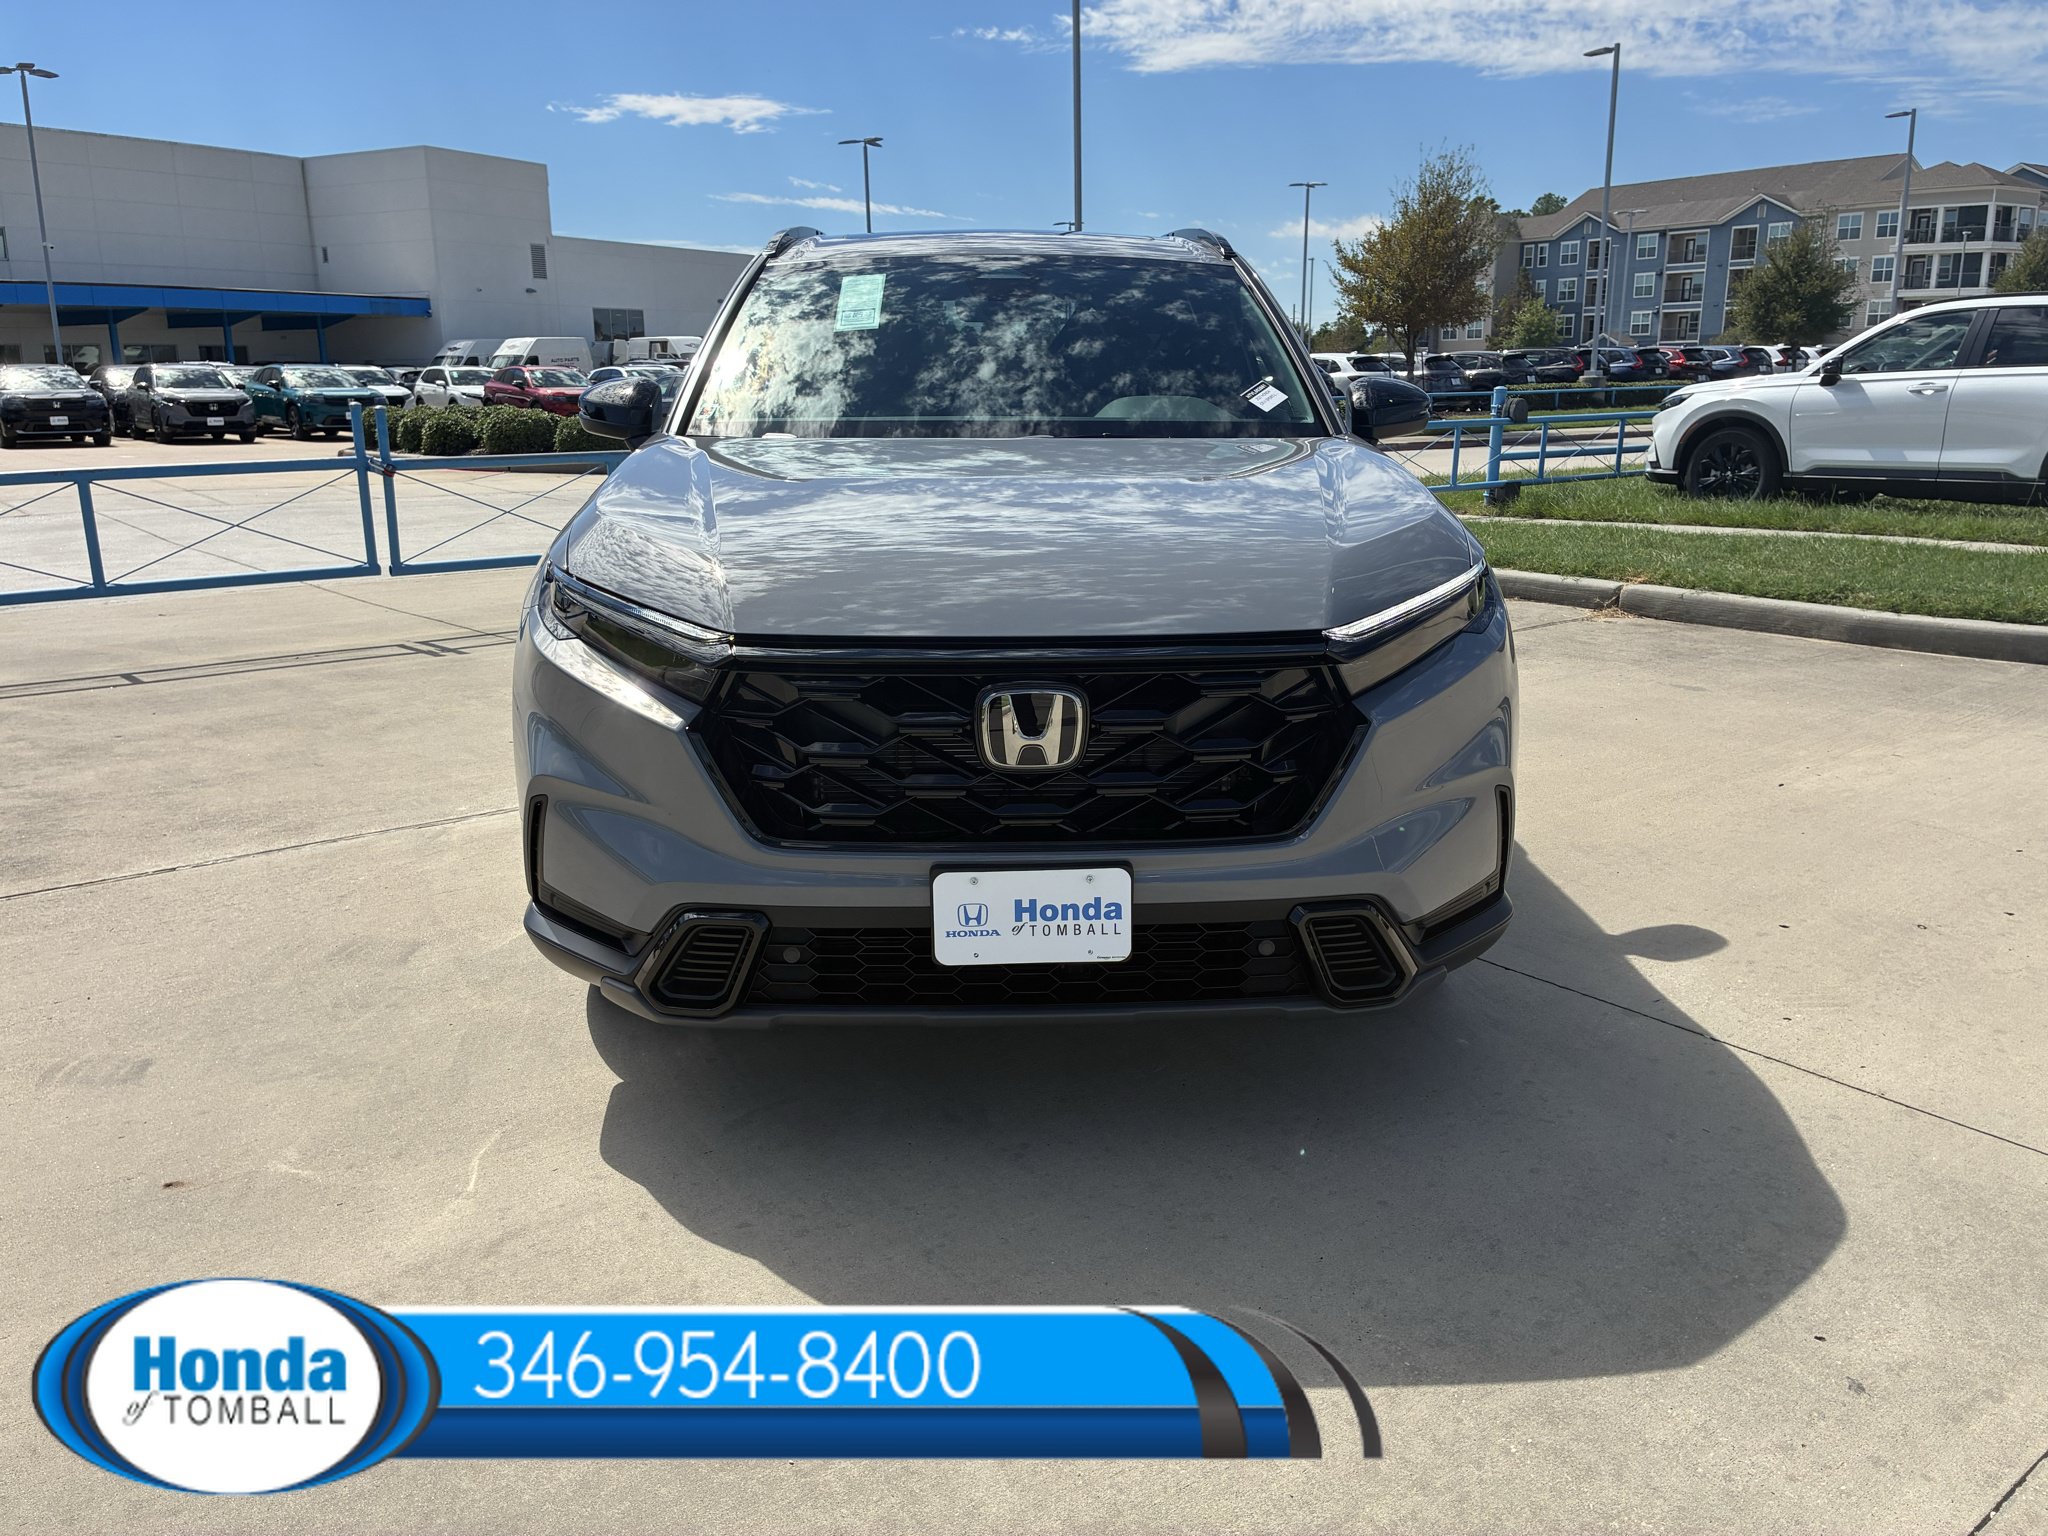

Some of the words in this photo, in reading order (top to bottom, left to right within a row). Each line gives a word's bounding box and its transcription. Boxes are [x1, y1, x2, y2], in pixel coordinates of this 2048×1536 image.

[1014, 896, 1122, 923] Honda
[945, 929, 1001, 938] HONDA
[1011, 922, 1028, 936] of
[1029, 923, 1122, 937] TOMBALL
